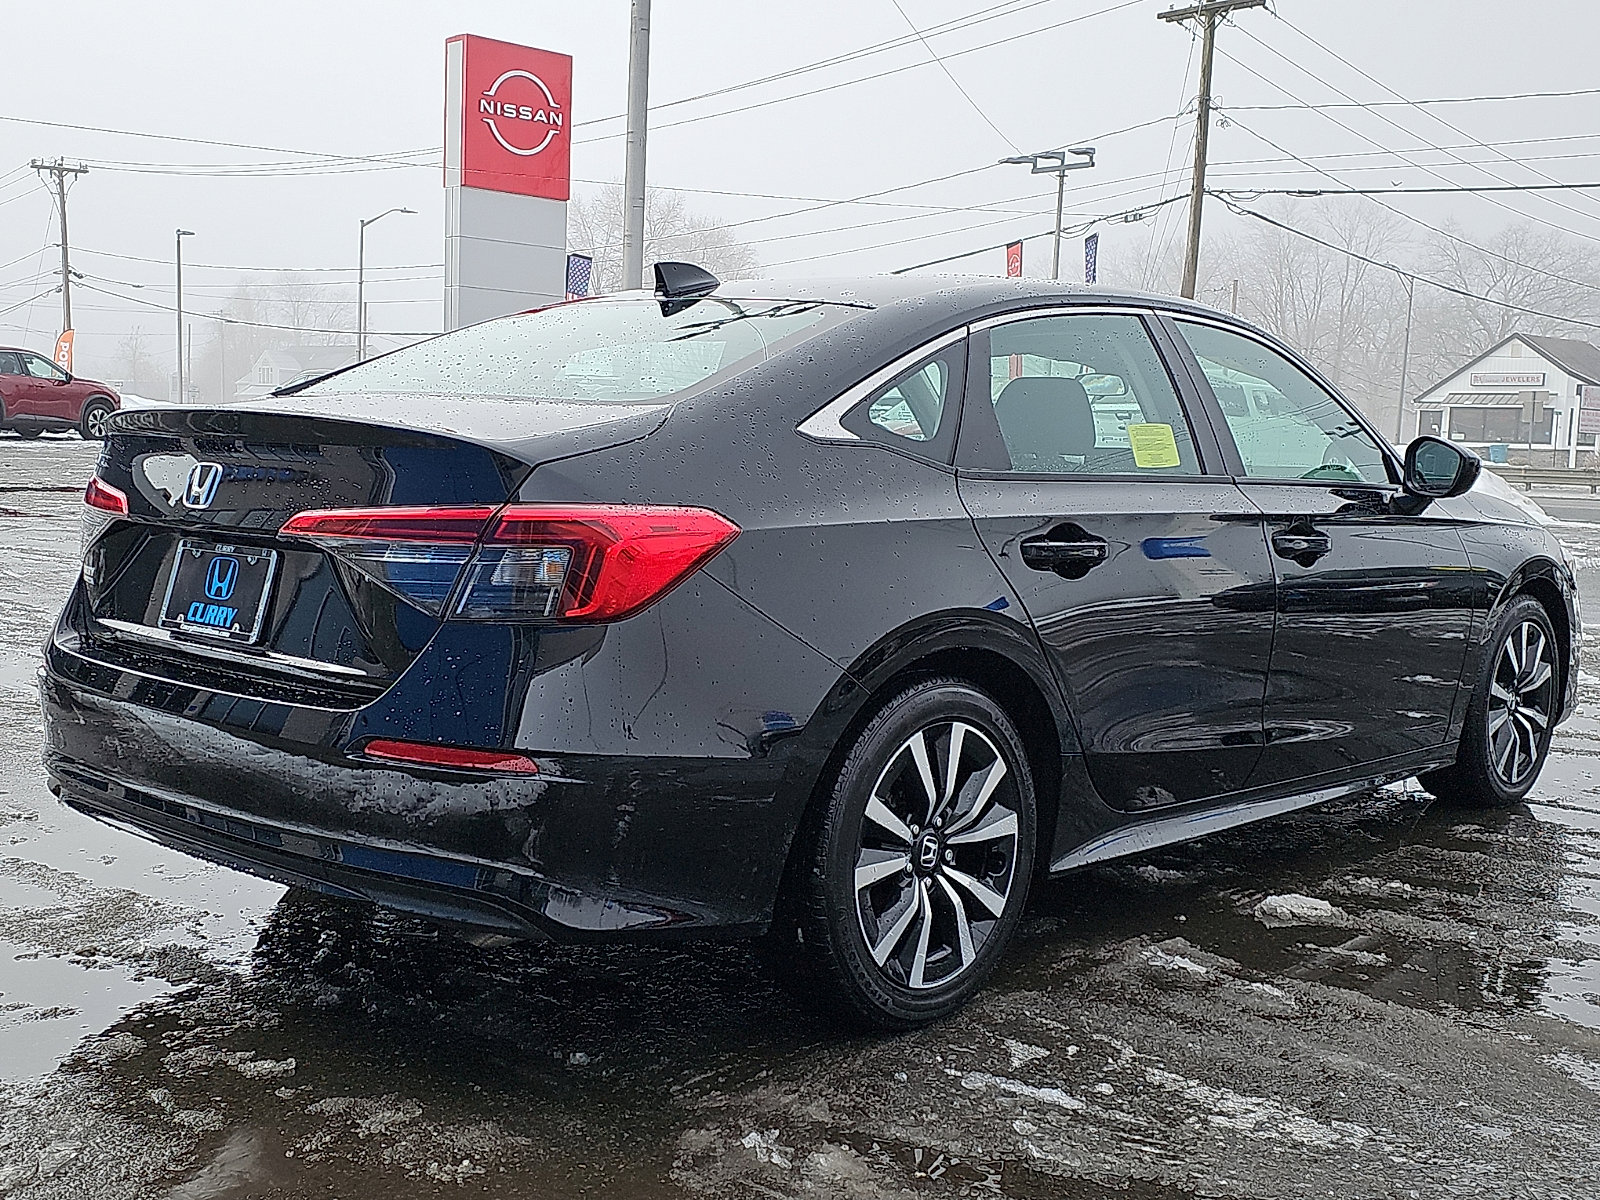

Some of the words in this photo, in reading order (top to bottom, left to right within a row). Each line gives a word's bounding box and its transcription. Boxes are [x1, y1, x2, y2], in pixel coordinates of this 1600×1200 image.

[479, 99, 562, 126] NISSAN
[215, 544, 236, 553] CURRY
[187, 602, 238, 628] CURRY
